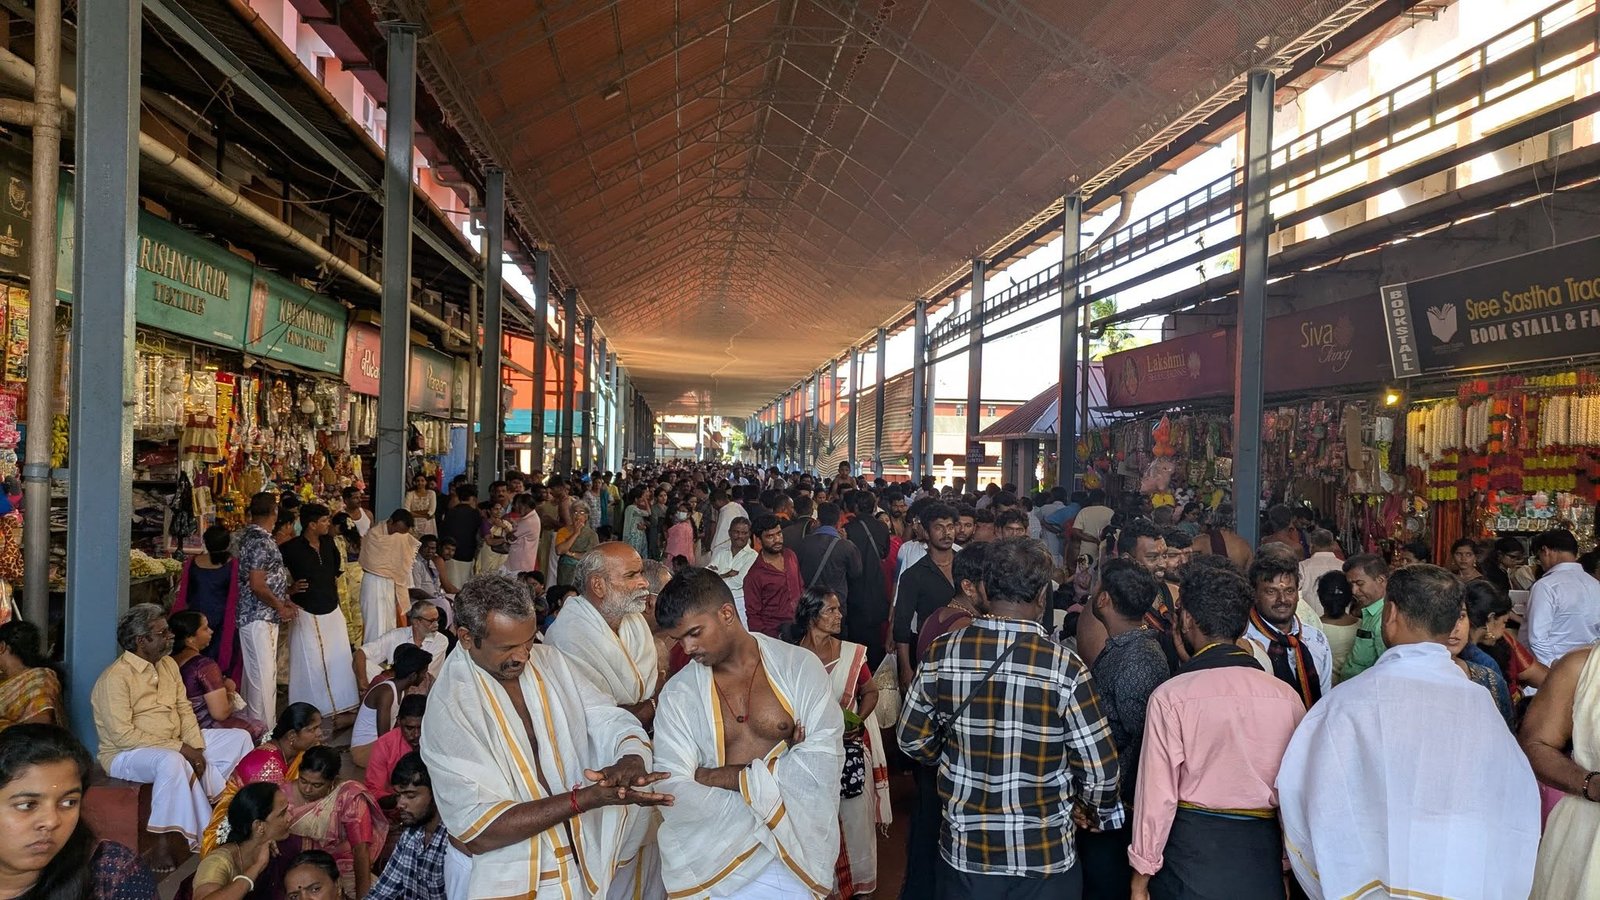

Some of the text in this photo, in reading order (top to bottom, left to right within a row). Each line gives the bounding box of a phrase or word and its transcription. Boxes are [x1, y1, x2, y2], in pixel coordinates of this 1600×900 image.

[138, 237, 230, 300] RISHNAKRIPA
[154, 282, 206, 316] TEXTILES
[1465, 298, 1500, 320] Sree
[1502, 284, 1562, 314] Sastha
[1301, 321, 1333, 348] Siva
[1389, 290, 1415, 371] BOOKSTALL
[1470, 323, 1507, 345] BOOK
[1511, 315, 1561, 338] STALL
[1565, 312, 1577, 331] &
[1146, 348, 1186, 373] Lakshmi
